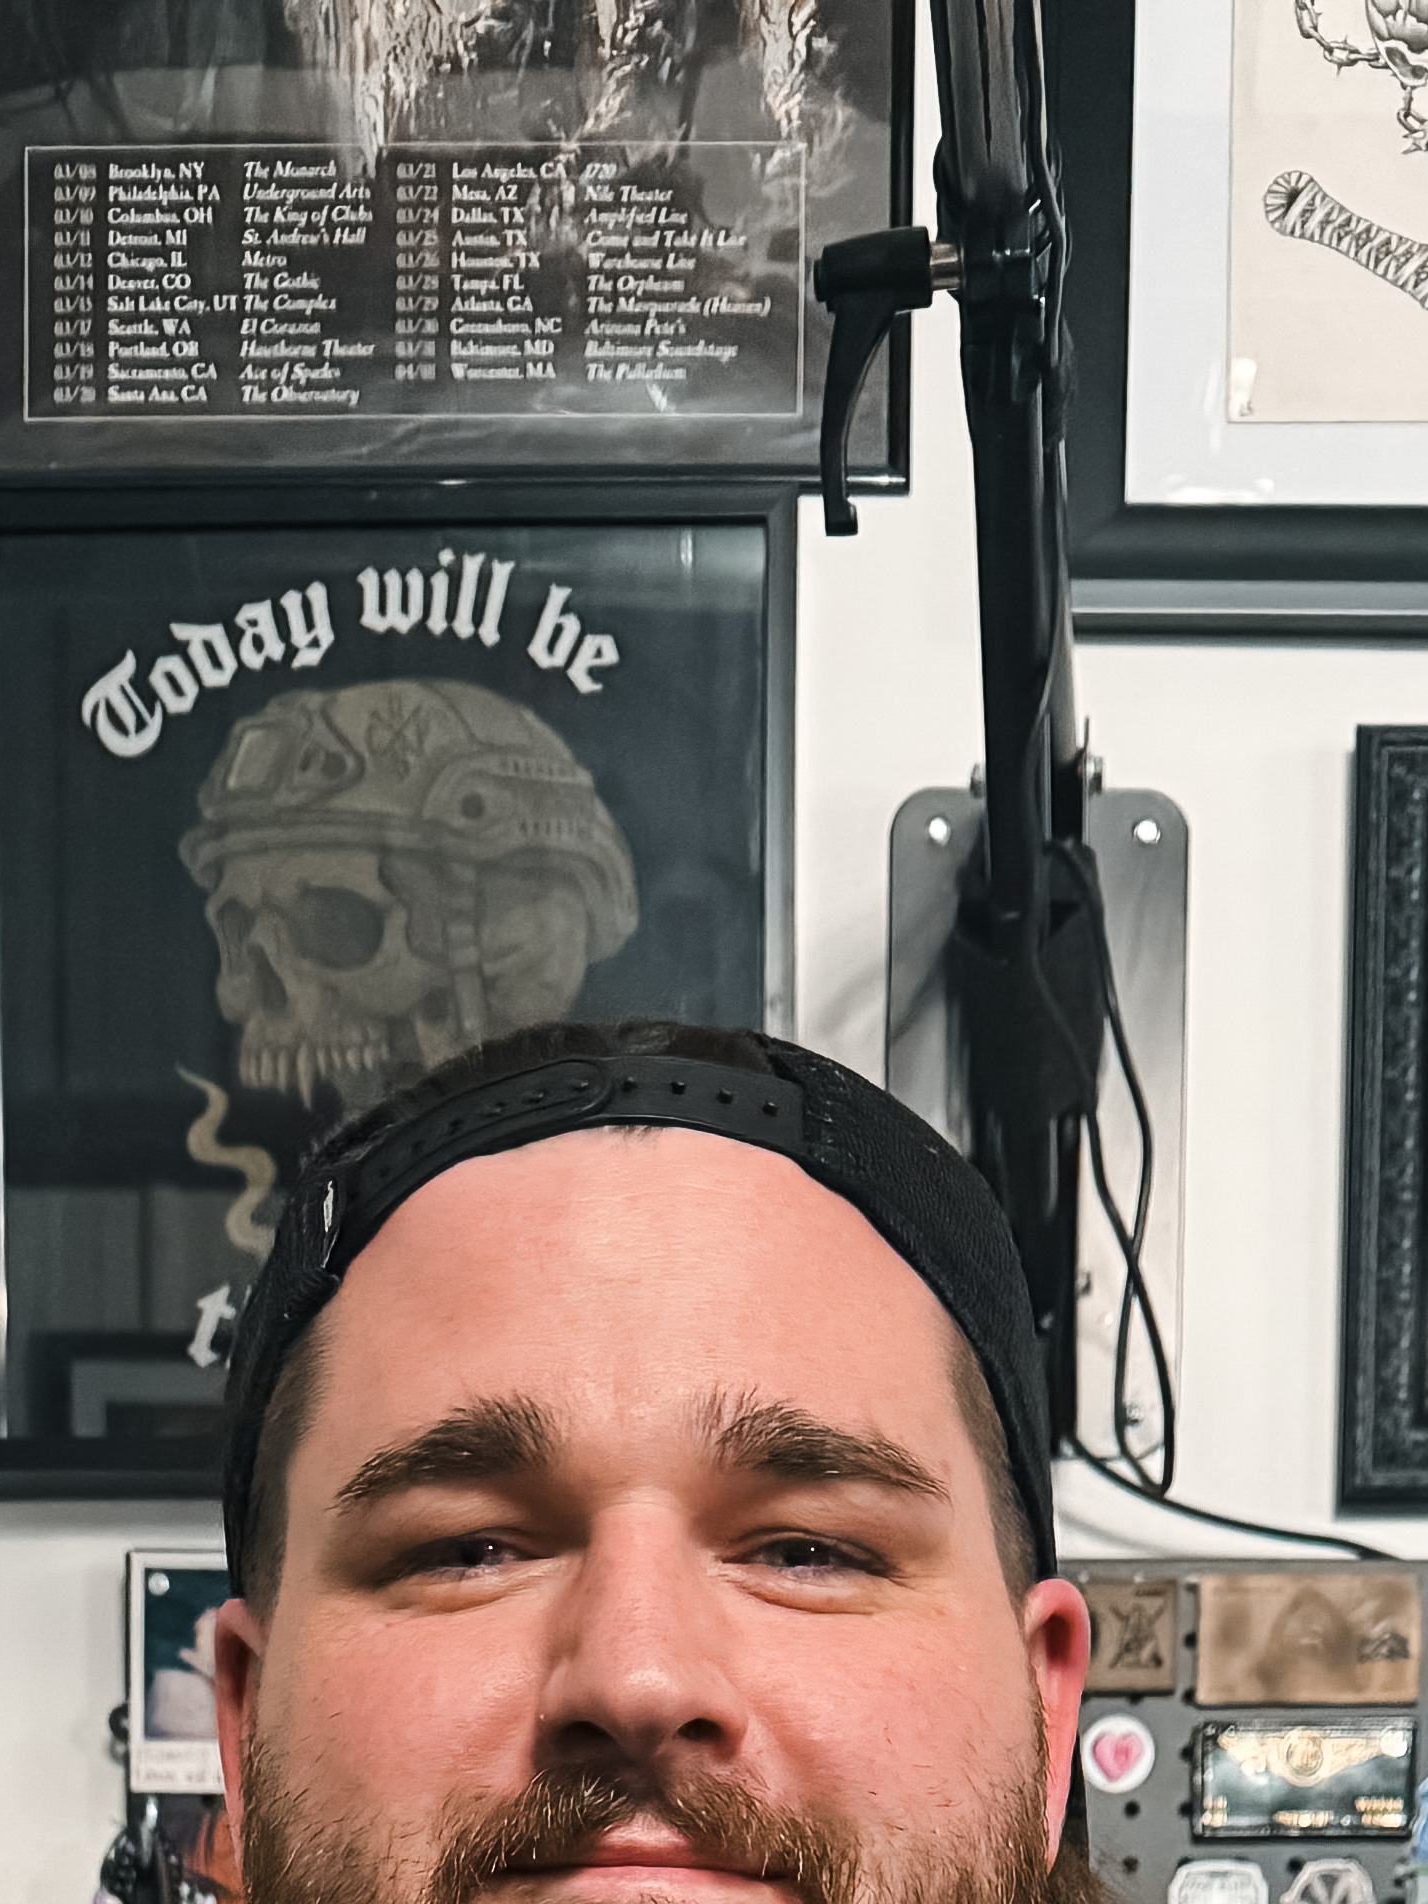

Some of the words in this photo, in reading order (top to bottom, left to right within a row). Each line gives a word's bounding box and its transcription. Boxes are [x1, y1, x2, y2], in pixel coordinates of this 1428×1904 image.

[179, 162, 204, 179] NY
[244, 161, 268, 178] The
[273, 160, 336, 178] Monarch
[452, 162, 477, 178] Los
[540, 162, 566, 178] CA
[198, 185, 220, 200] PA
[244, 183, 336, 204] Underground
[339, 183, 371, 200] Arts
[495, 185, 517, 200] AZ
[584, 185, 614, 201] Nile
[184, 208, 212, 224] OH
[244, 207, 268, 224] The
[274, 206, 312, 227] King
[312, 206, 327, 226] of
[332, 206, 372, 222] Clubs
[501, 207, 524, 222] TX
[584, 208, 657, 228] Amplified
[166, 230, 187, 245] MI
[334, 228, 365, 244] Hall
[503, 230, 526, 245] TX
[586, 231, 629, 247] Come
[633, 232, 660, 247] and
[663, 231, 696, 247] Take
[171, 252, 187, 267] IL
[243, 251, 287, 267] Metro
[517, 253, 540, 268] TX
[163, 274, 191, 289] CO
[244, 273, 268, 289] The
[503, 275, 524, 290] FL
[587, 275, 613, 291] The
[108, 296, 134, 312] Salt
[139, 296, 170, 312] Lake
[214, 295, 238, 310] UT
[243, 295, 269, 312] The
[273, 294, 336, 315] Complex
[587, 297, 613, 312] The
[163, 319, 191, 334] WA
[240, 318, 257, 334] El
[535, 318, 561, 333] NC
[173, 341, 198, 356] OR
[524, 340, 554, 356] MD
[191, 363, 217, 379] CA
[239, 363, 268, 379] Ace
[271, 362, 288, 383] of
[527, 363, 555, 379] MA
[587, 364, 613, 380] The
[108, 386, 145, 403] Santa
[181, 386, 207, 402] CA
[242, 385, 267, 403] The
[271, 385, 359, 406] Observatory
[81, 578, 335, 760] Today
[356, 548, 515, 648] will
[527, 583, 622, 695] be
